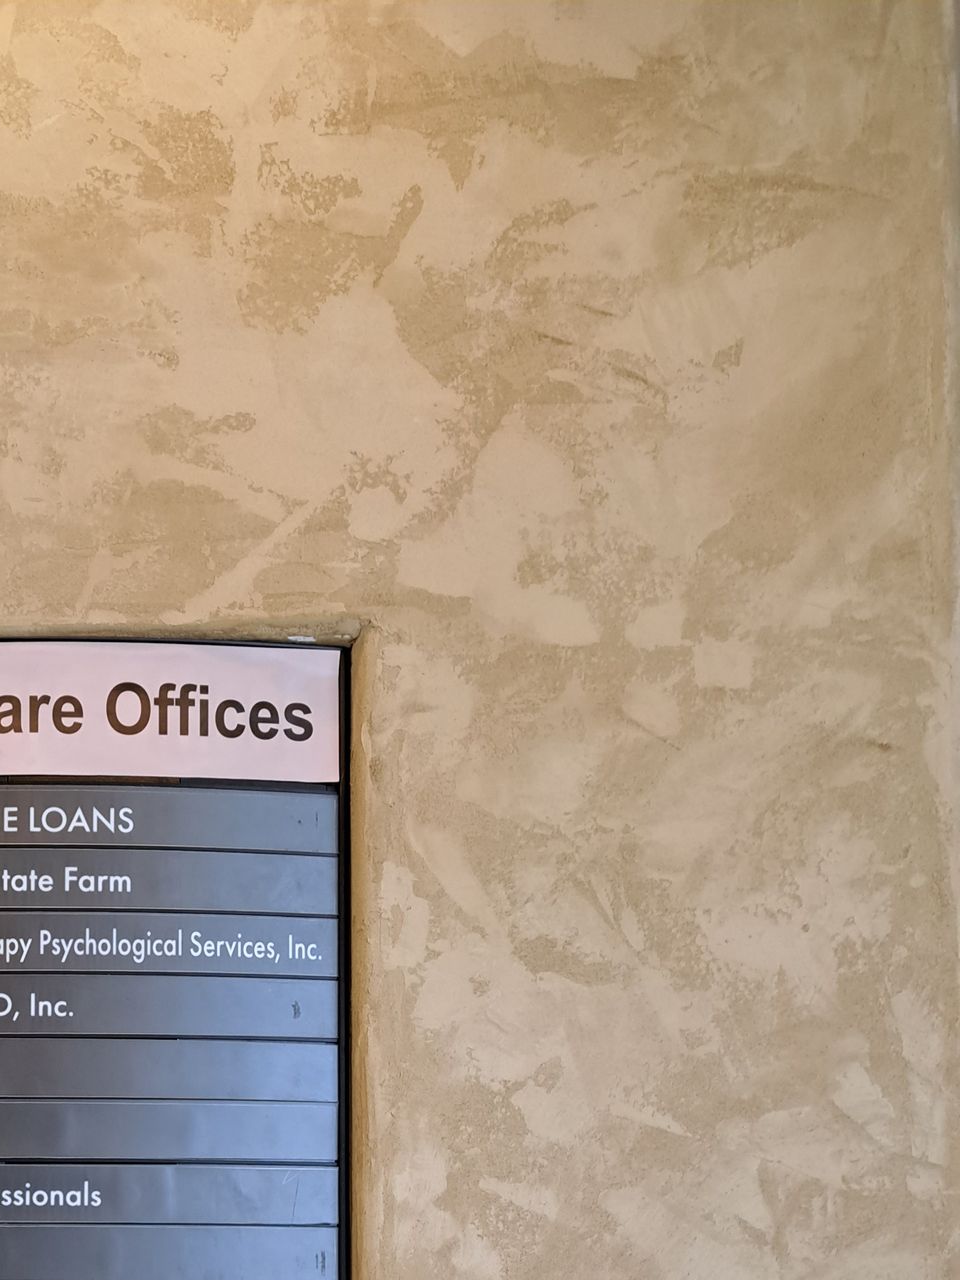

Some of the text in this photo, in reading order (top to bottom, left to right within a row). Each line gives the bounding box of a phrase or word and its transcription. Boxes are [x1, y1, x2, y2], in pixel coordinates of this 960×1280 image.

[105, 681, 314, 742] Offices
[29, 805, 135, 834] LOANS
[64, 866, 132, 893] Farm
[39, 927, 183, 964] Psychological
[189, 930, 281, 964] Services,
[288, 934, 323, 961] Inc.
[30, 992, 74, 1018] Inc.
